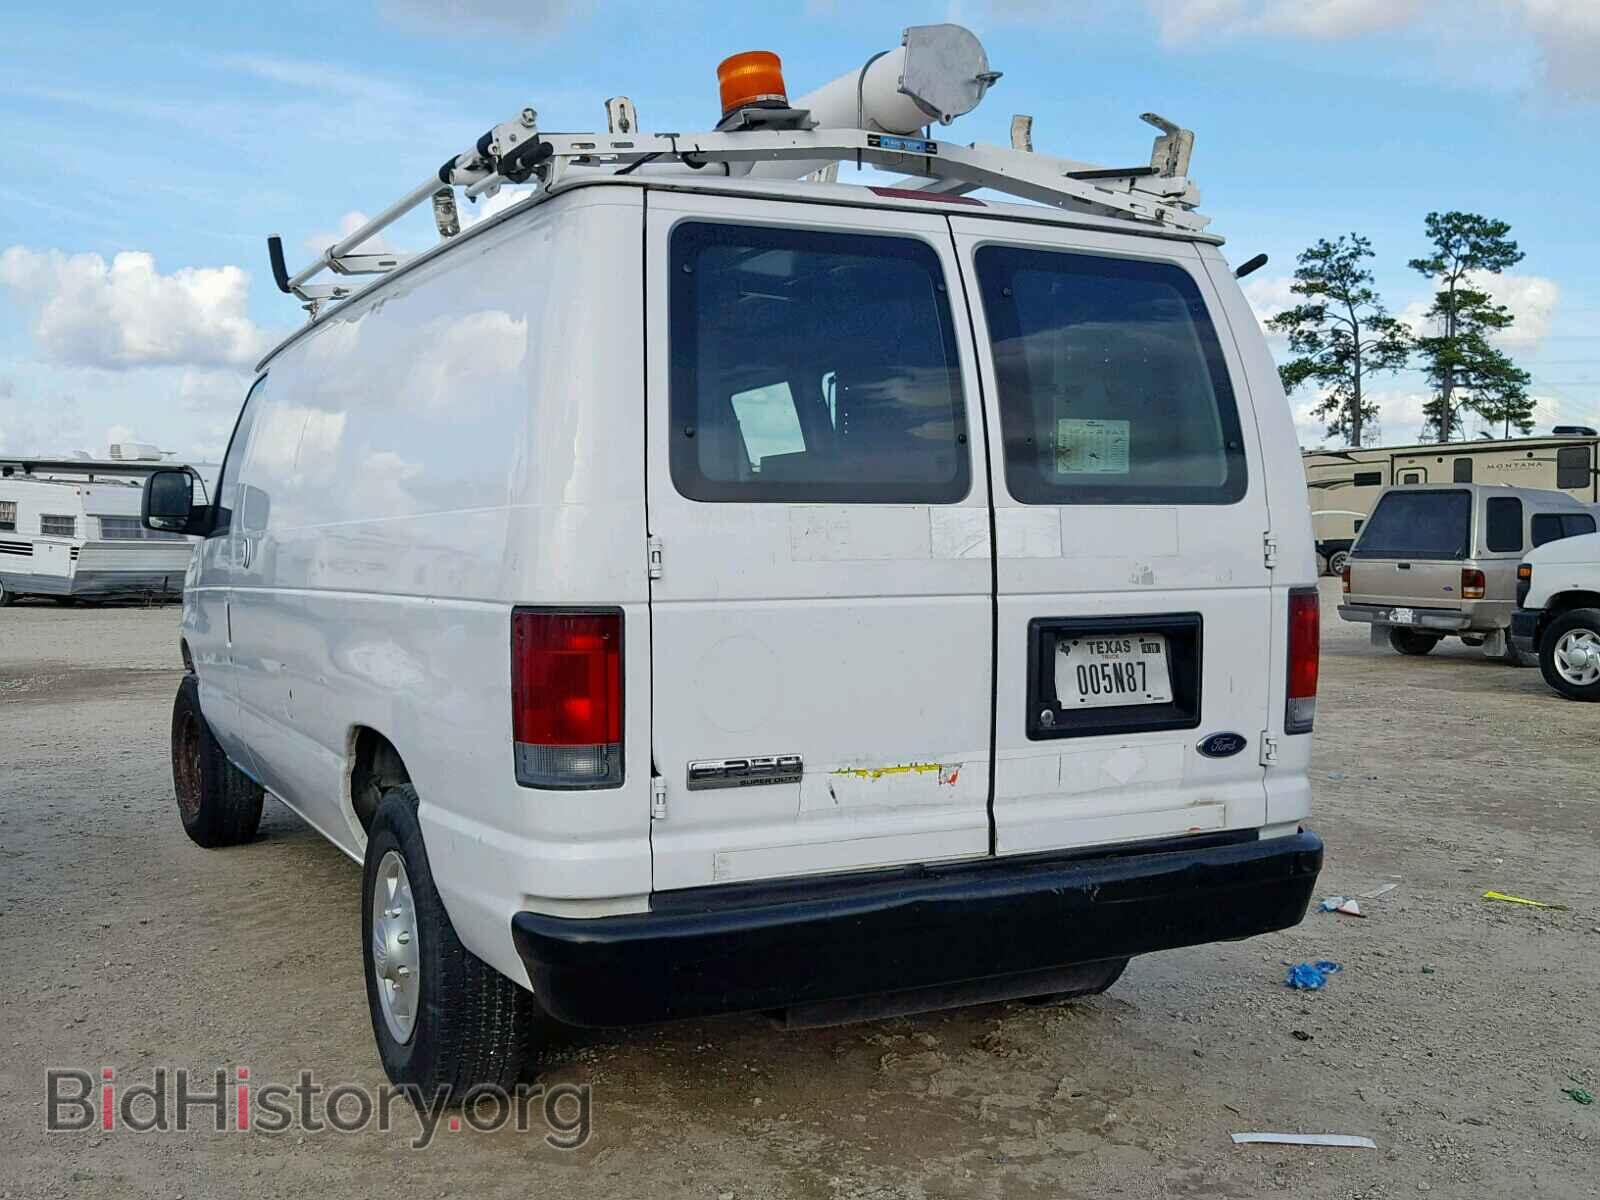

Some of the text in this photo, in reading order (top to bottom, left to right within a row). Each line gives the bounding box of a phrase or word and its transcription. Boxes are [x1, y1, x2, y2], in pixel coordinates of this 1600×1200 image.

[1086, 640, 1131, 655] TEXAS
[1076, 661, 1146, 695] 005N87
[1210, 737, 1237, 752] Ford
[740, 775, 801, 786] SUPER DUTY
